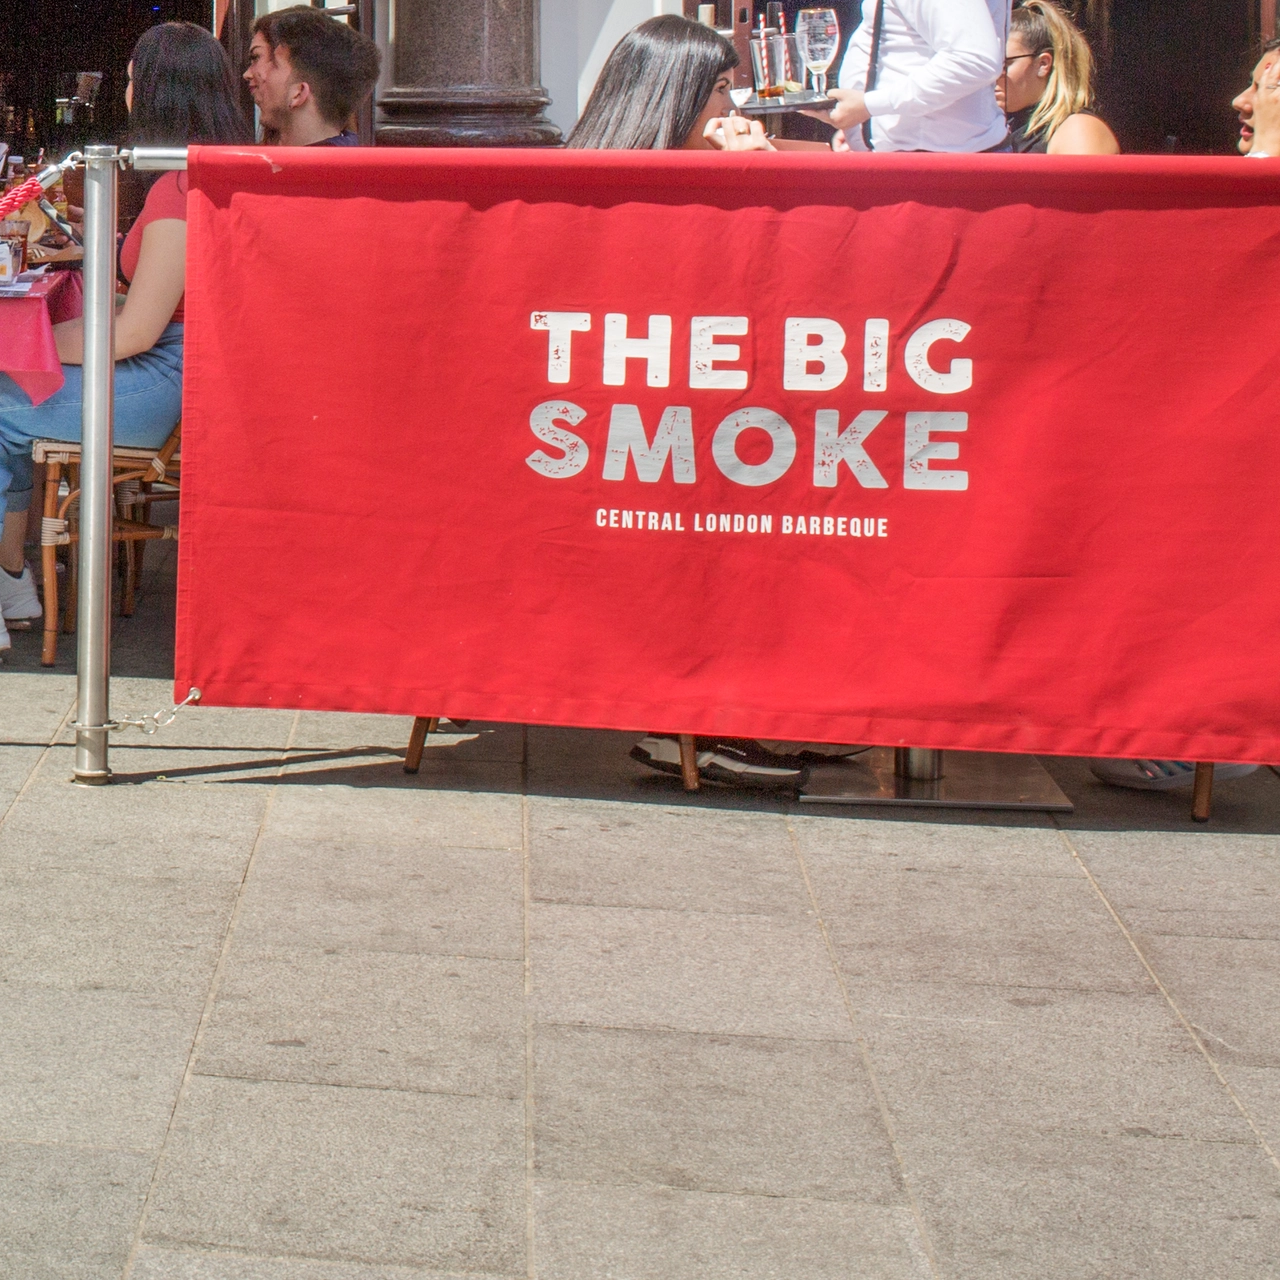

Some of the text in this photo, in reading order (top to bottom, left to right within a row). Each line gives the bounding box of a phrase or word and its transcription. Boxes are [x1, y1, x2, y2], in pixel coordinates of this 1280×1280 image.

[528, 310, 973, 394] THE BIG
[524, 399, 970, 491] SMOKE
[595, 506, 890, 539] CENTRAL LONDON BARBEQUE
